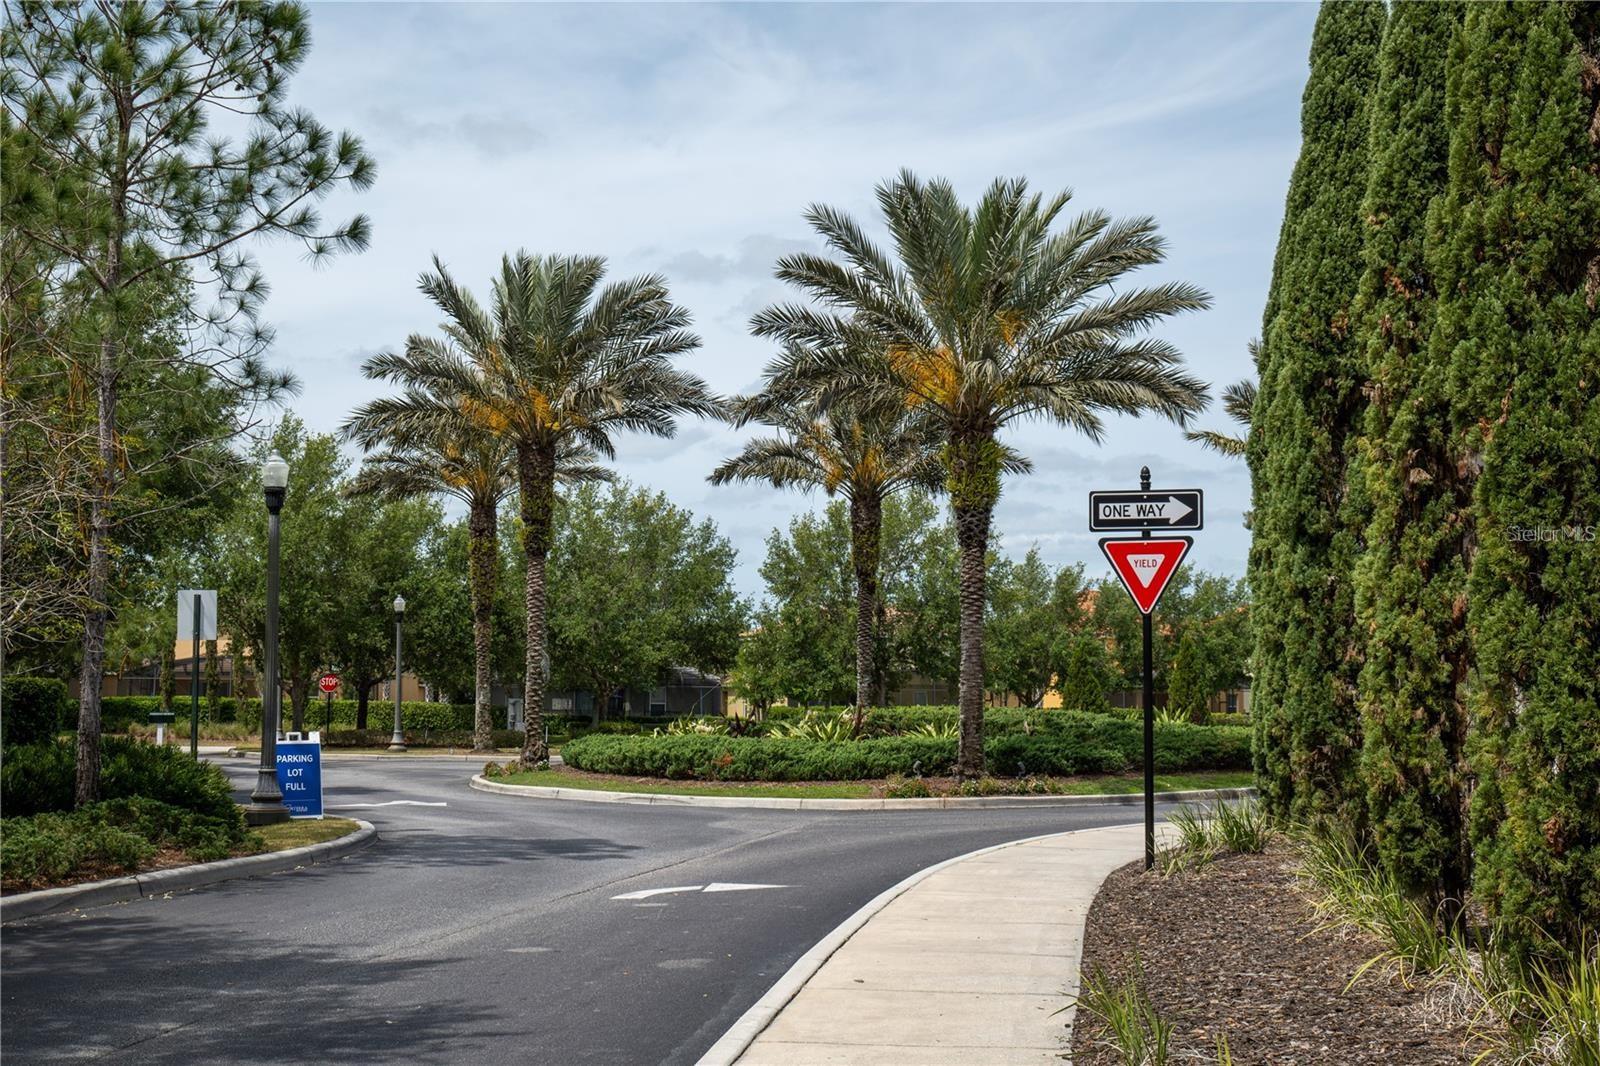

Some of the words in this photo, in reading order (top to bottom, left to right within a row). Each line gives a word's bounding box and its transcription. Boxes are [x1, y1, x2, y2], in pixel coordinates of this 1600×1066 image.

[1103, 504, 1131, 518] ONE
[1136, 504, 1165, 517] WAY
[1133, 559, 1158, 568] YIELD
[320, 677, 338, 686] STOP
[276, 754, 313, 763] PARKING
[287, 768, 303, 777] LOT
[285, 782, 306, 791] FULL
